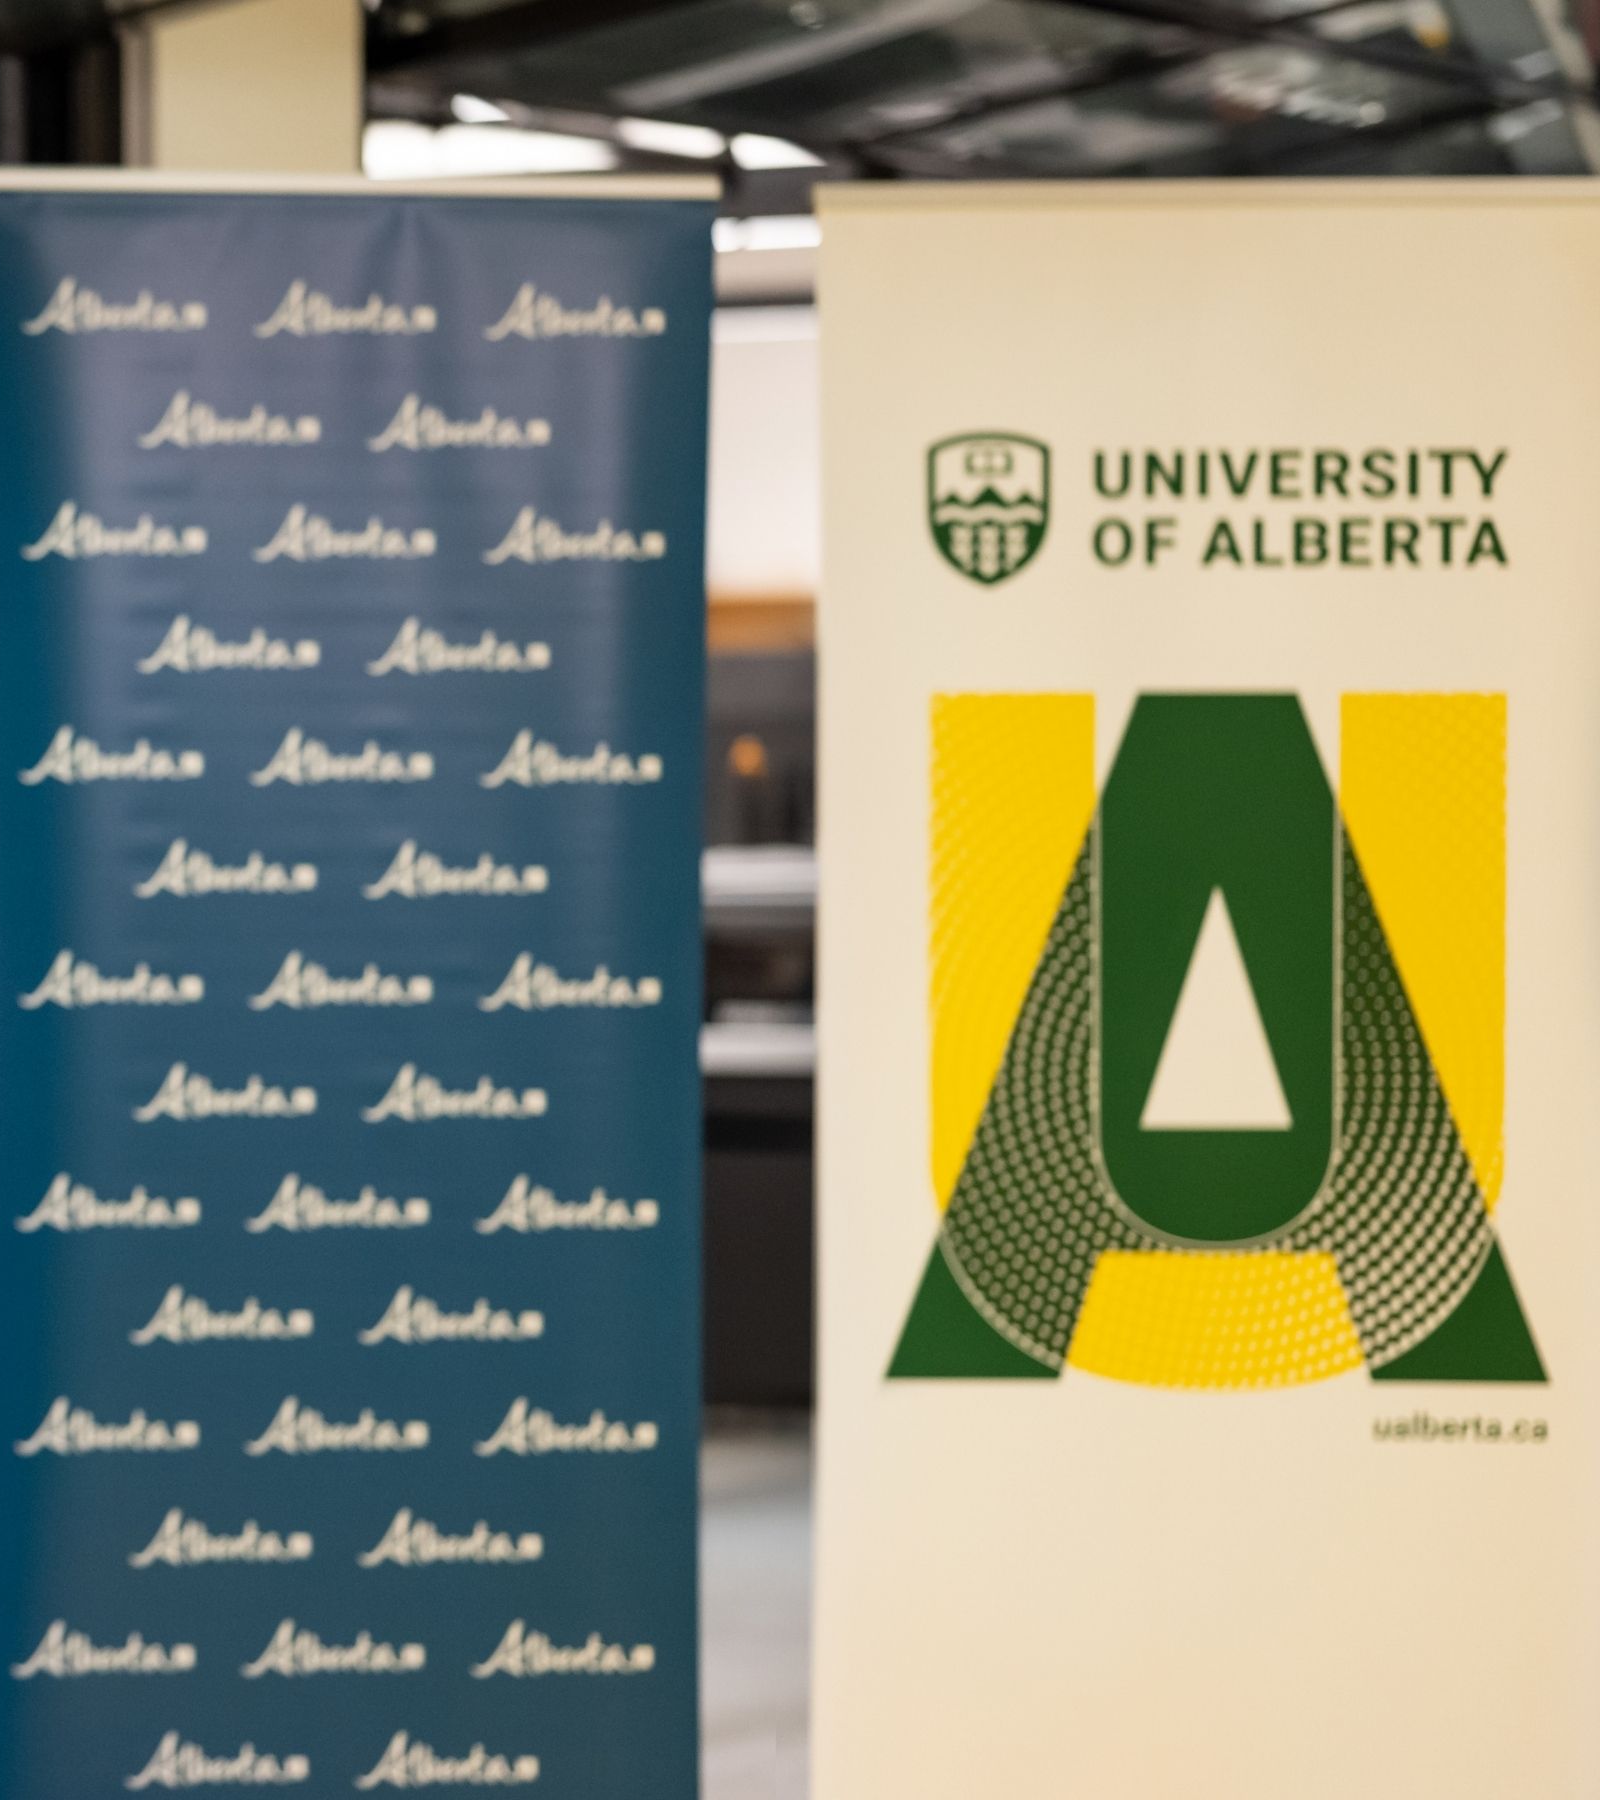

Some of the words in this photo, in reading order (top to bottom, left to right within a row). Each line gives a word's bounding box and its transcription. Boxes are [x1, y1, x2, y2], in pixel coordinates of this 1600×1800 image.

[21, 277, 186, 337] Alberta
[250, 280, 415, 338] Alberta
[481, 282, 646, 341] Alberta
[135, 391, 300, 449] Alberta
[365, 393, 530, 452] Alberta
[1092, 447, 1509, 500] UNIVERSITY
[20, 501, 187, 563] Alberta
[251, 503, 416, 563] Alberta
[481, 505, 646, 566] Alberta
[1091, 516, 1175, 568] OF
[1201, 516, 1510, 568] ALBERTA
[135, 615, 300, 675] Alberta
[365, 616, 530, 677] Alberta
[17, 724, 184, 787] Alberta
[249, 727, 414, 788] Alberta
[478, 728, 643, 790] Alberta
[133, 838, 298, 900] Alberta
[364, 838, 529, 901] Alberta
[17, 948, 184, 1012] Alberta
[249, 949, 414, 1012] Alberta
[477, 950, 642, 1014] Alberta
[132, 1060, 297, 1124] Alberta
[362, 1061, 528, 1124] Alberta
[14, 1171, 181, 1235] Alberta
[245, 1171, 410, 1235] Alberta
[474, 1172, 639, 1236] Alberta
[129, 1283, 294, 1347] Alberta
[359, 1283, 524, 1347] Alberta
[13, 1395, 180, 1459] Alberta
[245, 1394, 410, 1458] Alberta
[473, 1395, 638, 1458] Alberta
[1372, 1412, 1549, 1444] ualberta.ca
[128, 1506, 293, 1570] Alberta
[358, 1506, 523, 1569] Alberta
[10, 1618, 176, 1681] Alberta
[241, 1617, 406, 1680] Alberta
[470, 1617, 635, 1680] Alberta
[125, 1729, 290, 1791] Alberta
[355, 1729, 520, 1791] Alberta
